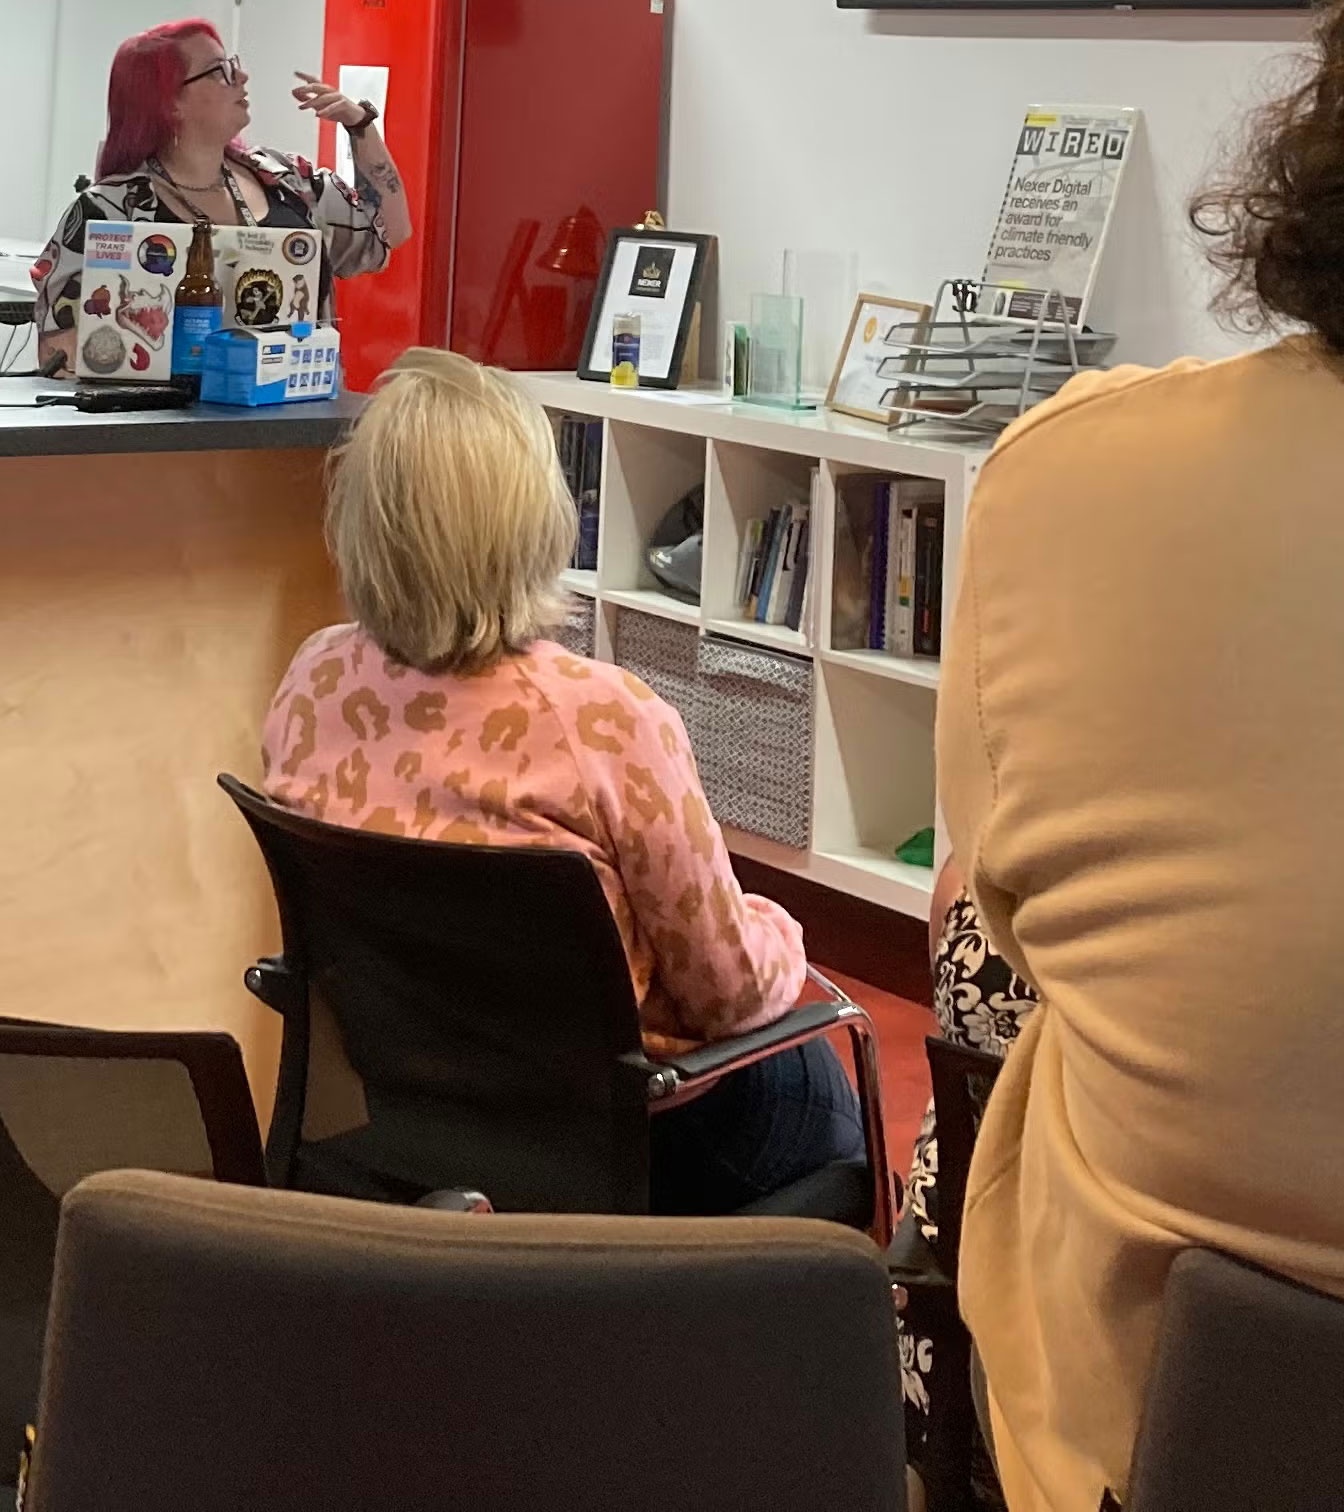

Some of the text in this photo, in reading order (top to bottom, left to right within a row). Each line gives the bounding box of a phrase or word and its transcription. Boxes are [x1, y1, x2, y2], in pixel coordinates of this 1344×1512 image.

[1017, 127, 1129, 160] WIRED
[1014, 176, 1093, 198] Nexer Digital
[1009, 197, 1078, 211] receives an
[1005, 212, 1064, 228] award for
[89, 232, 133, 243] PROTECT
[1000, 227, 1094, 252] climate friendly
[95, 242, 126, 251] TRANS
[994, 245, 1052, 262] practices
[96, 251, 123, 260] LIVES
